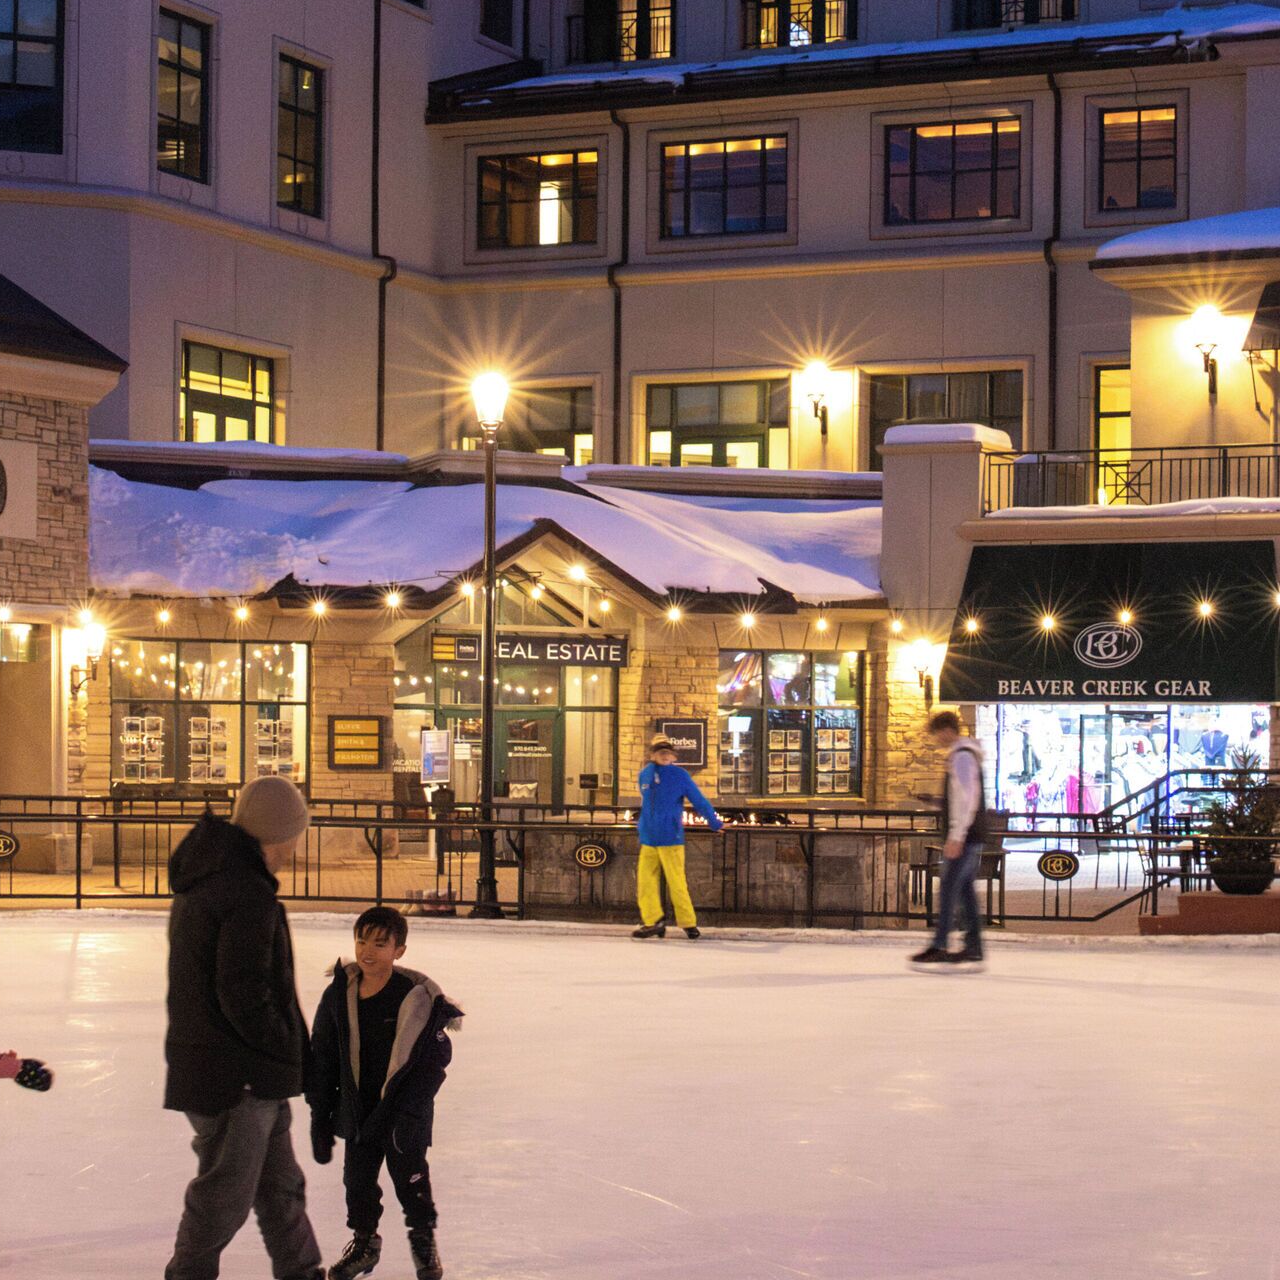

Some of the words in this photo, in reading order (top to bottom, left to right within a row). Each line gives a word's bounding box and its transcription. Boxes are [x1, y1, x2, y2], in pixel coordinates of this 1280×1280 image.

[494, 642, 539, 659] EAL
[547, 643, 621, 661] ESTATE
[998, 680, 1076, 696] BEAVER
[1082, 680, 1147, 696] CREEK
[1154, 680, 1212, 696] GEAR
[392, 759, 421, 767] VACATIO
